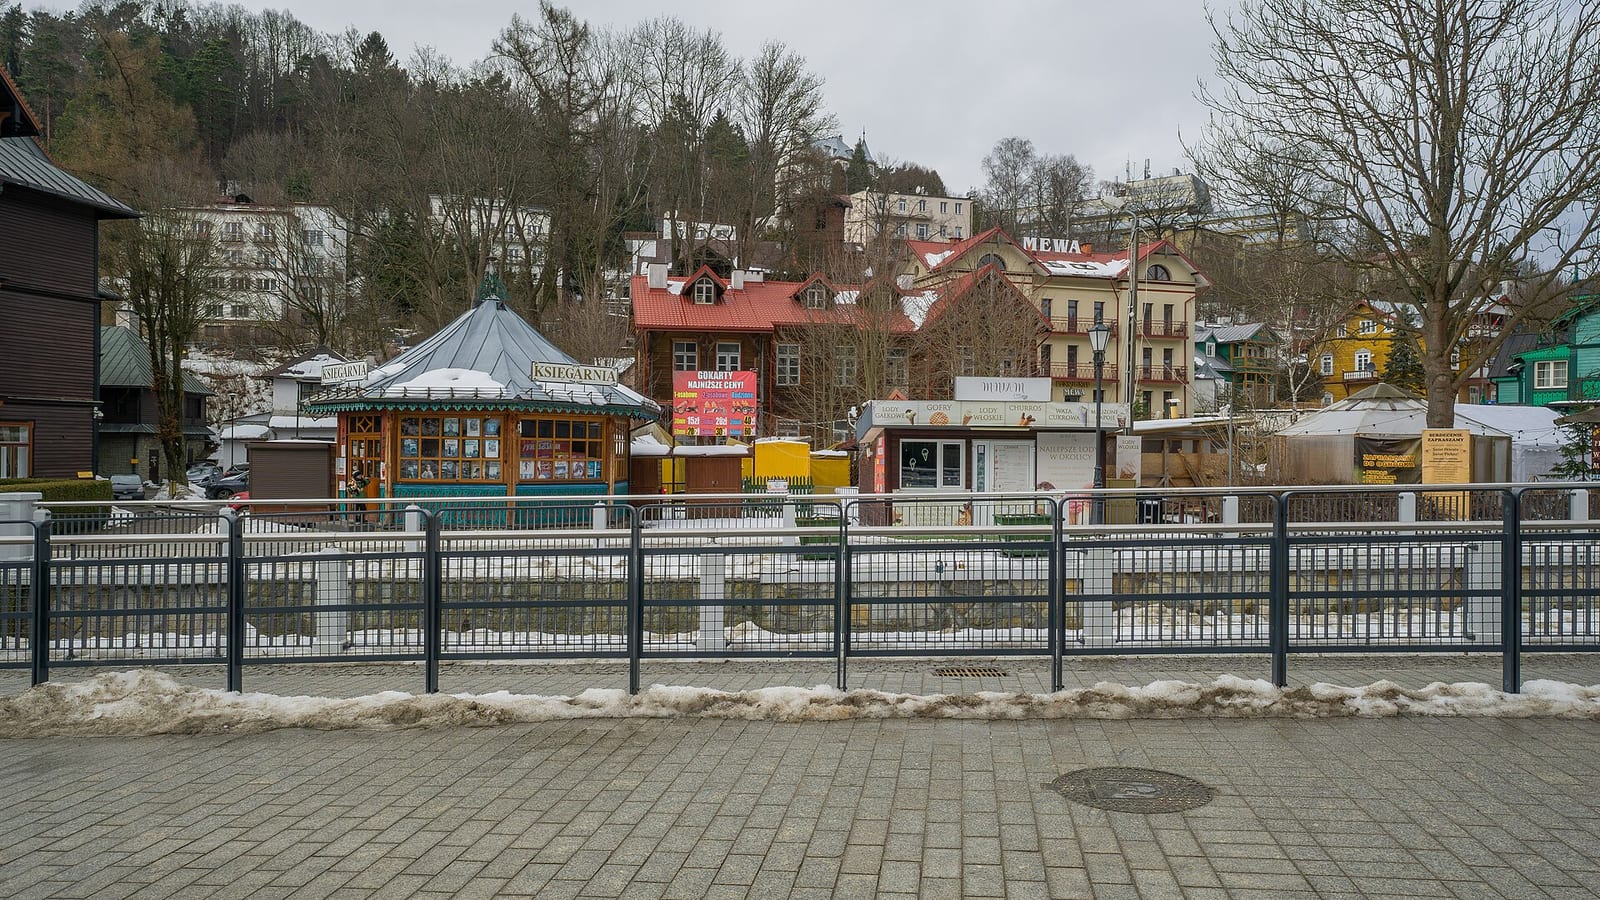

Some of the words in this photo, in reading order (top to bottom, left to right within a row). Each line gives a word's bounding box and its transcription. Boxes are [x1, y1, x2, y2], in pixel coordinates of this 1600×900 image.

[1023, 236, 1081, 254] MEWA
[697, 371, 733, 380] GOKARTY
[688, 380, 723, 389] NAJNIŻSZE
[926, 403, 953, 411] GOFRY
[1009, 404, 1042, 412] CHURROS
[1040, 446, 1077, 454] NAJLEPSZE
[1059, 453, 1092, 461] OKOLICY
